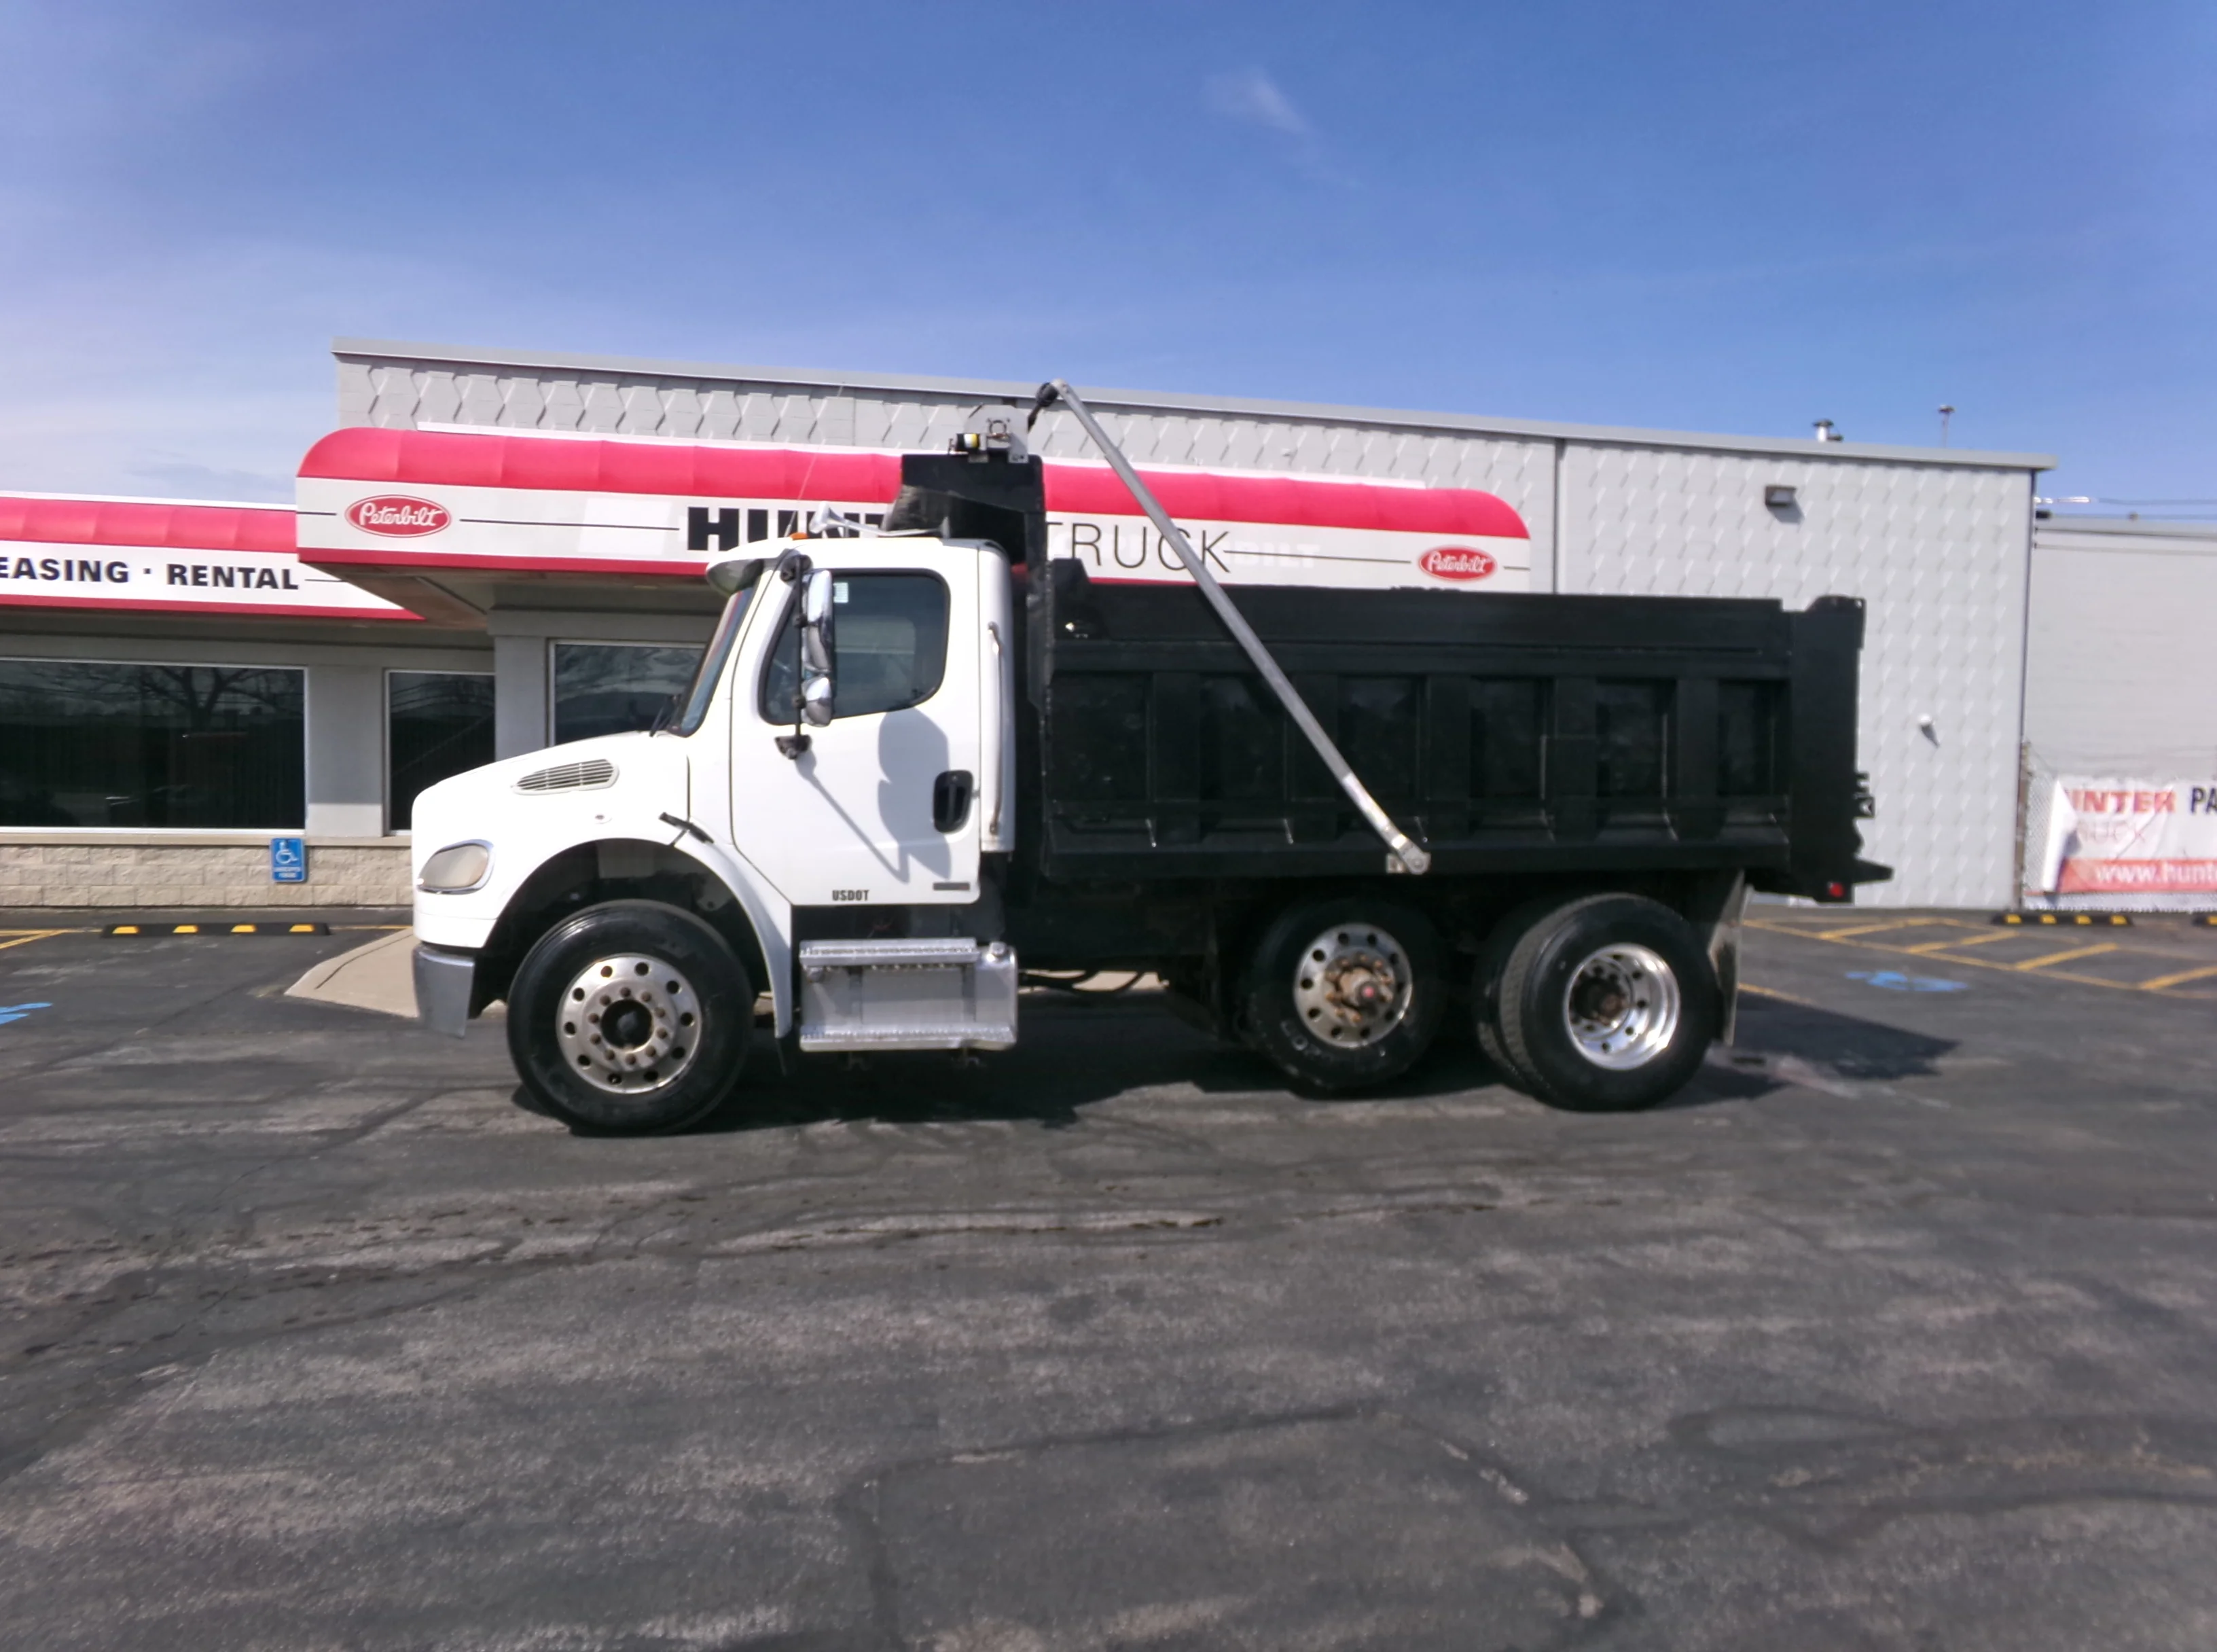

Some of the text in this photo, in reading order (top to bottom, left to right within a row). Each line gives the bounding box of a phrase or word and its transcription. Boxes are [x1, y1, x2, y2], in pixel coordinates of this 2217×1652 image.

[359, 502, 444, 526] Peterbilt
[1046, 521, 1230, 573] RUCK
[1428, 550, 1492, 573] Peterbilt
[166, 563, 299, 590] RENTAL
[832, 889, 869, 901] USDOT
